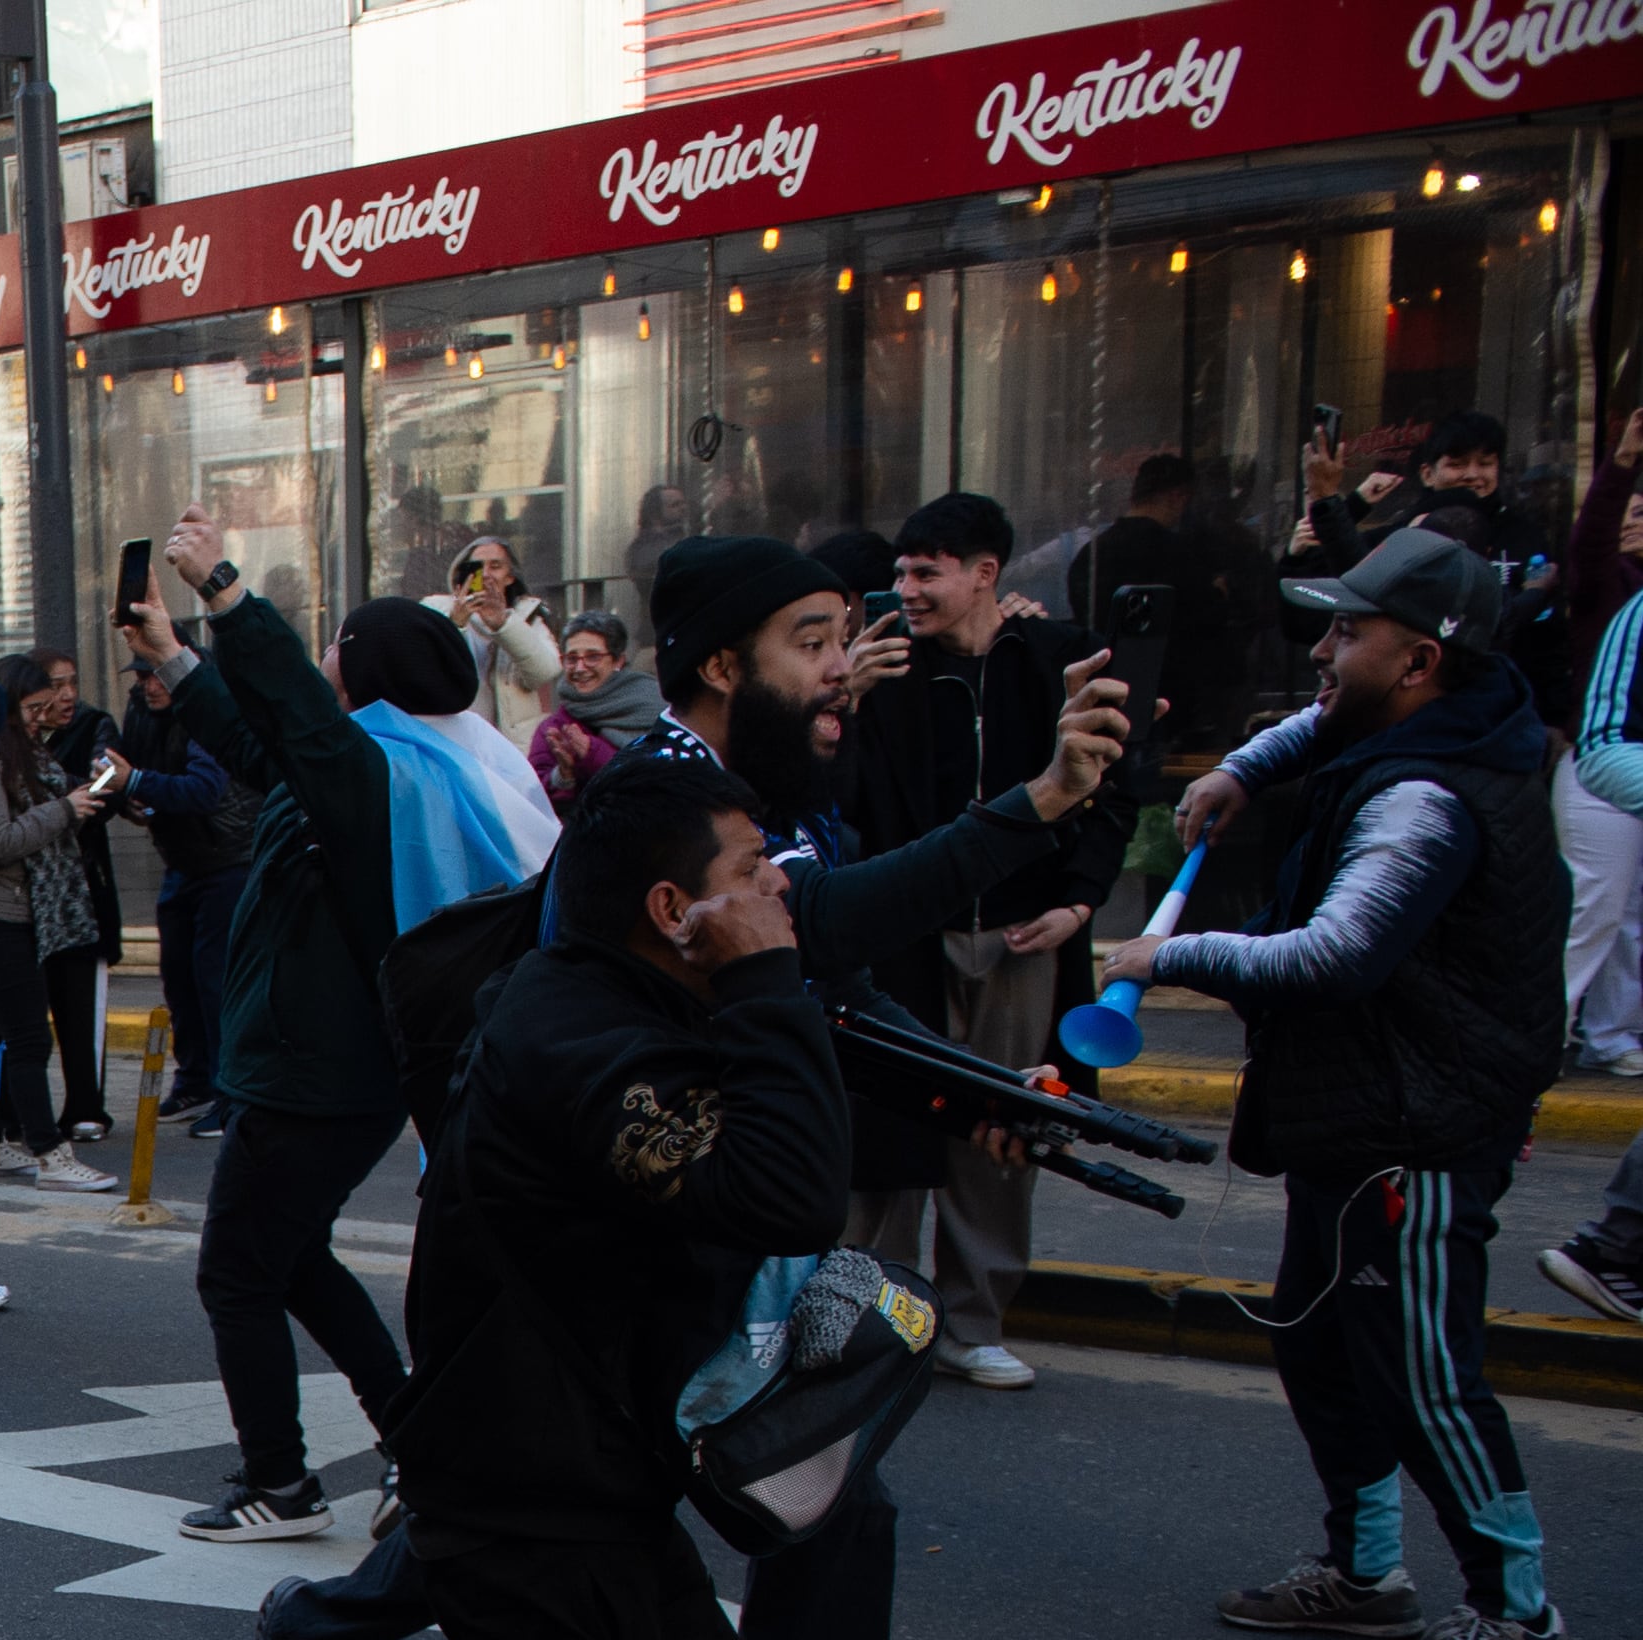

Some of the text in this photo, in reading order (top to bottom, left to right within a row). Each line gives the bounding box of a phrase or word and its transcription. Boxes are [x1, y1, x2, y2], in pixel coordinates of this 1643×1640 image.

[975, 37, 1242, 167] Kentucky
[599, 114, 819, 227] Kentucky
[62, 225, 211, 320] Kentucky
[292, 176, 480, 278] Kentucky
